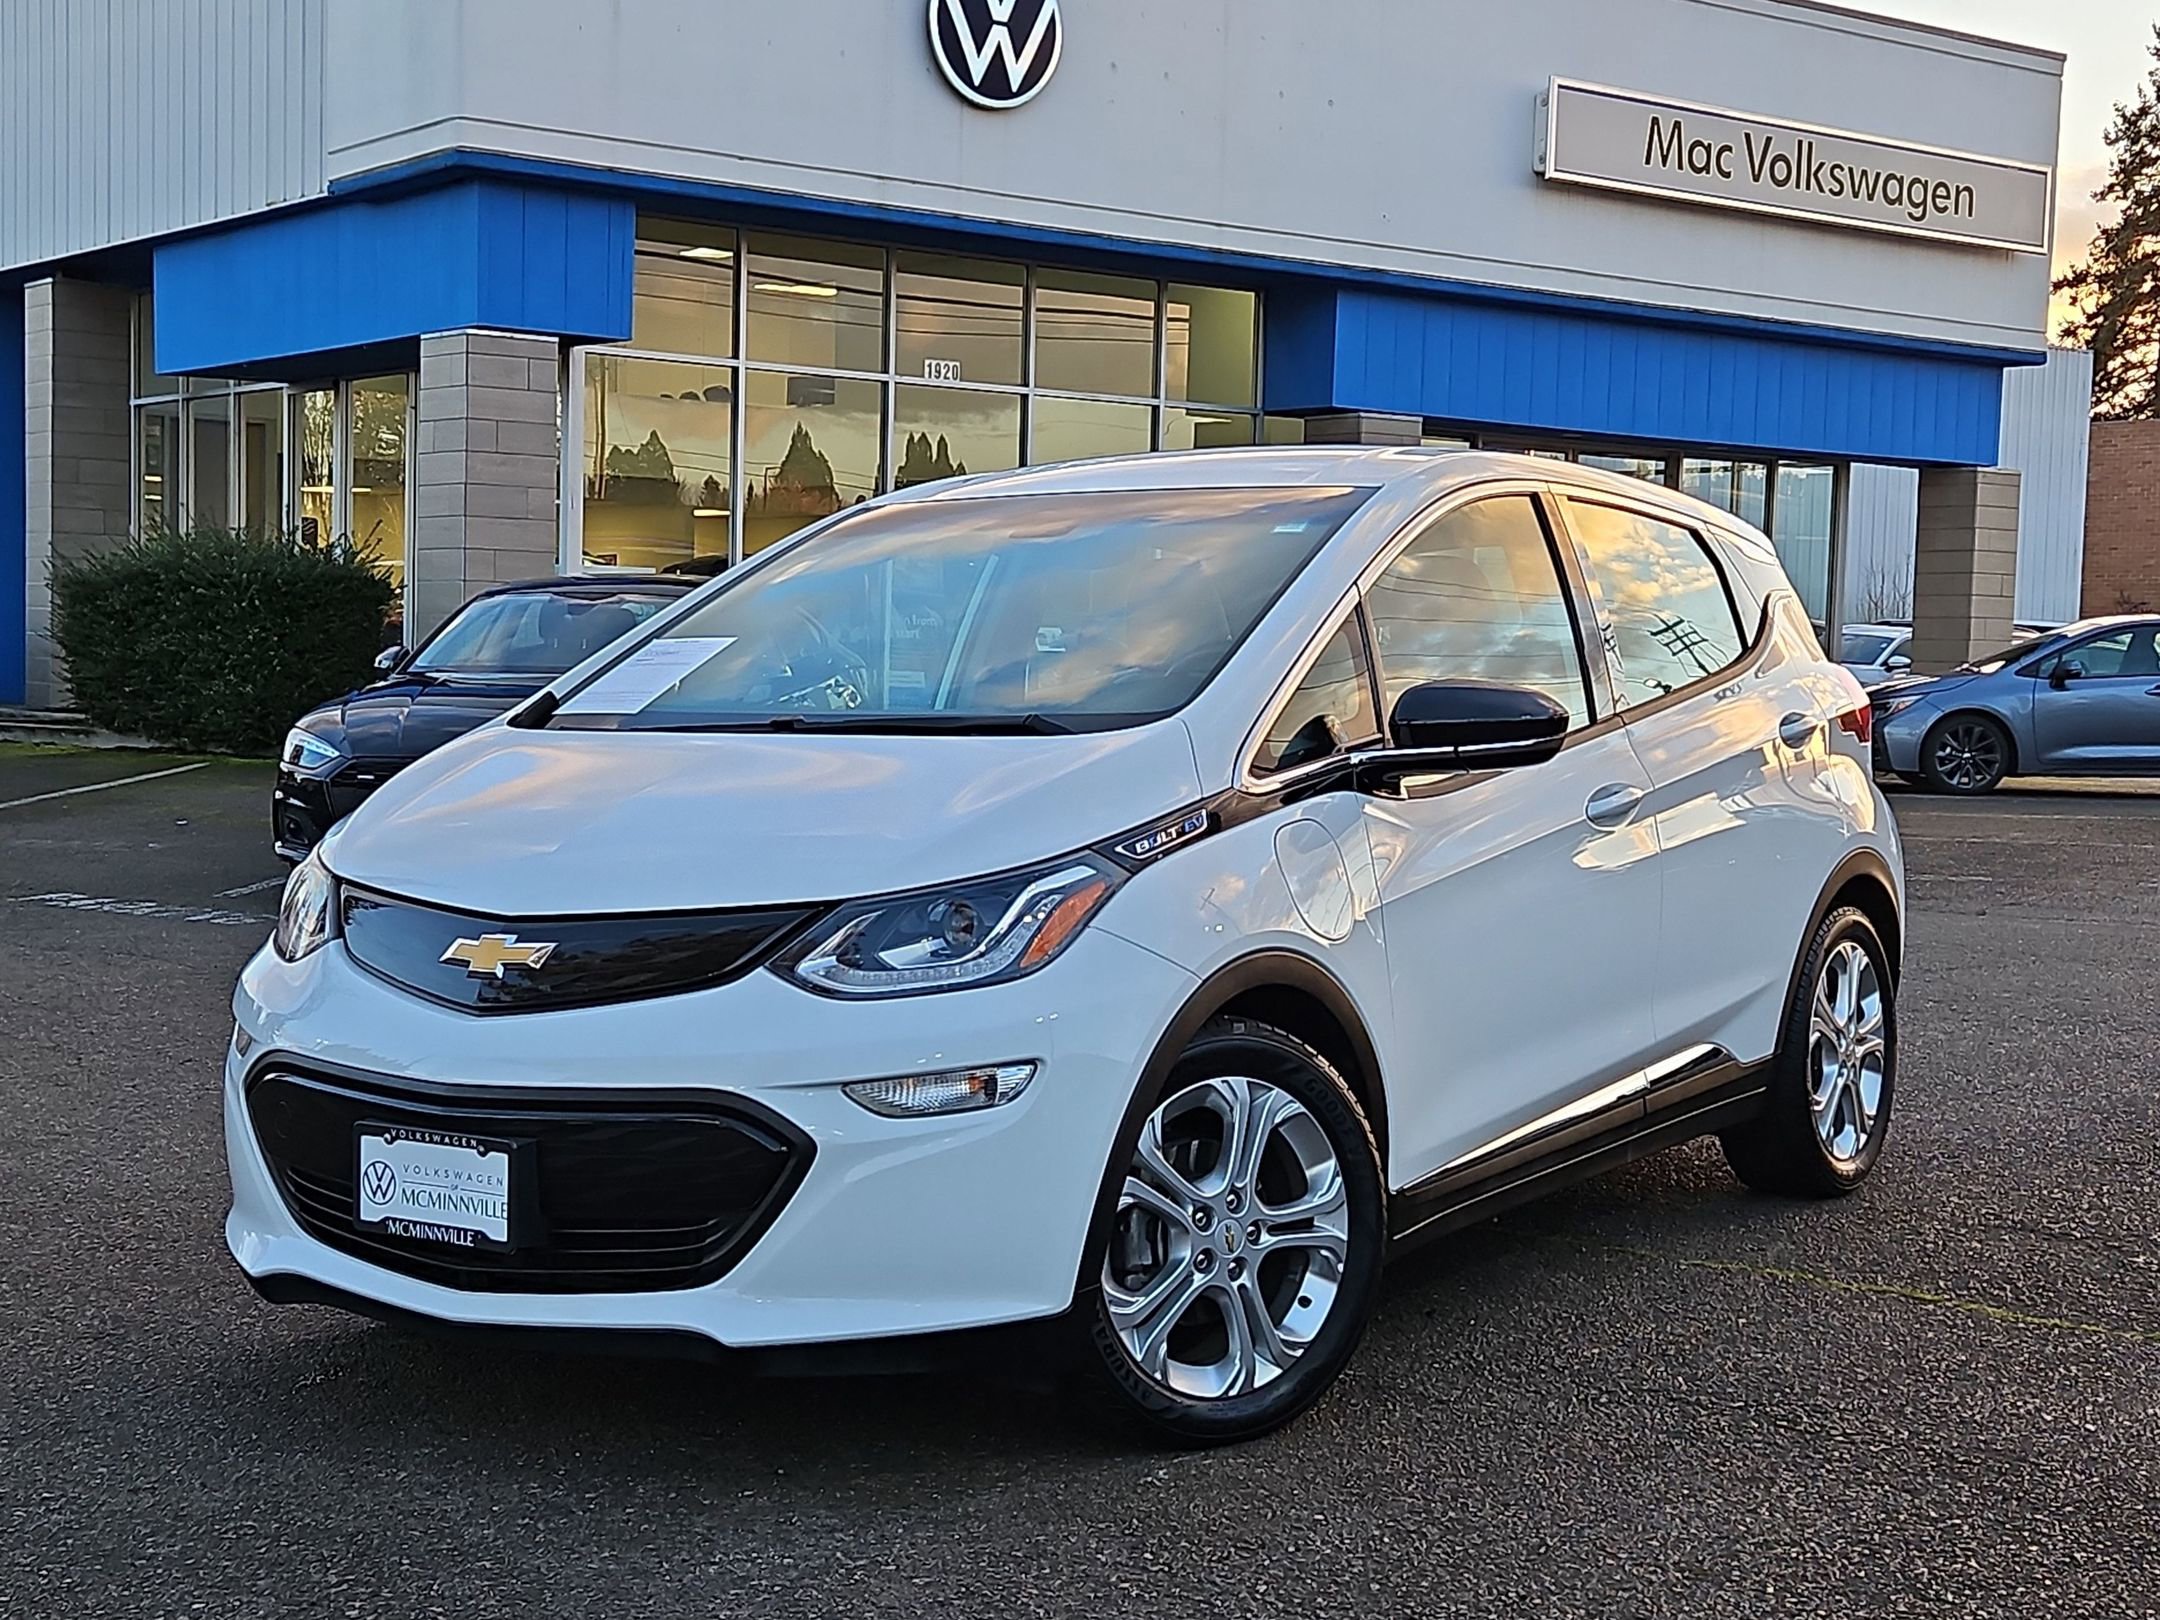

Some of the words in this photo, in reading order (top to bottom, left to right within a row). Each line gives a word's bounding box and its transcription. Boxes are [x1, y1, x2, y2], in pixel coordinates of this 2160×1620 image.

[1644, 116, 1733, 179] Mac
[1743, 131, 1974, 221] Volkswagen
[927, 362, 959, 380] 1920
[1135, 826, 1178, 853] BOLT
[1184, 814, 1204, 833] EV
[390, 1128, 477, 1148] VOLKSWAGEN
[403, 1164, 504, 1187] VOLKSWAGEN
[401, 1187, 508, 1219] MCMINNVILLE
[387, 1219, 475, 1246] MCMINNVILLE
